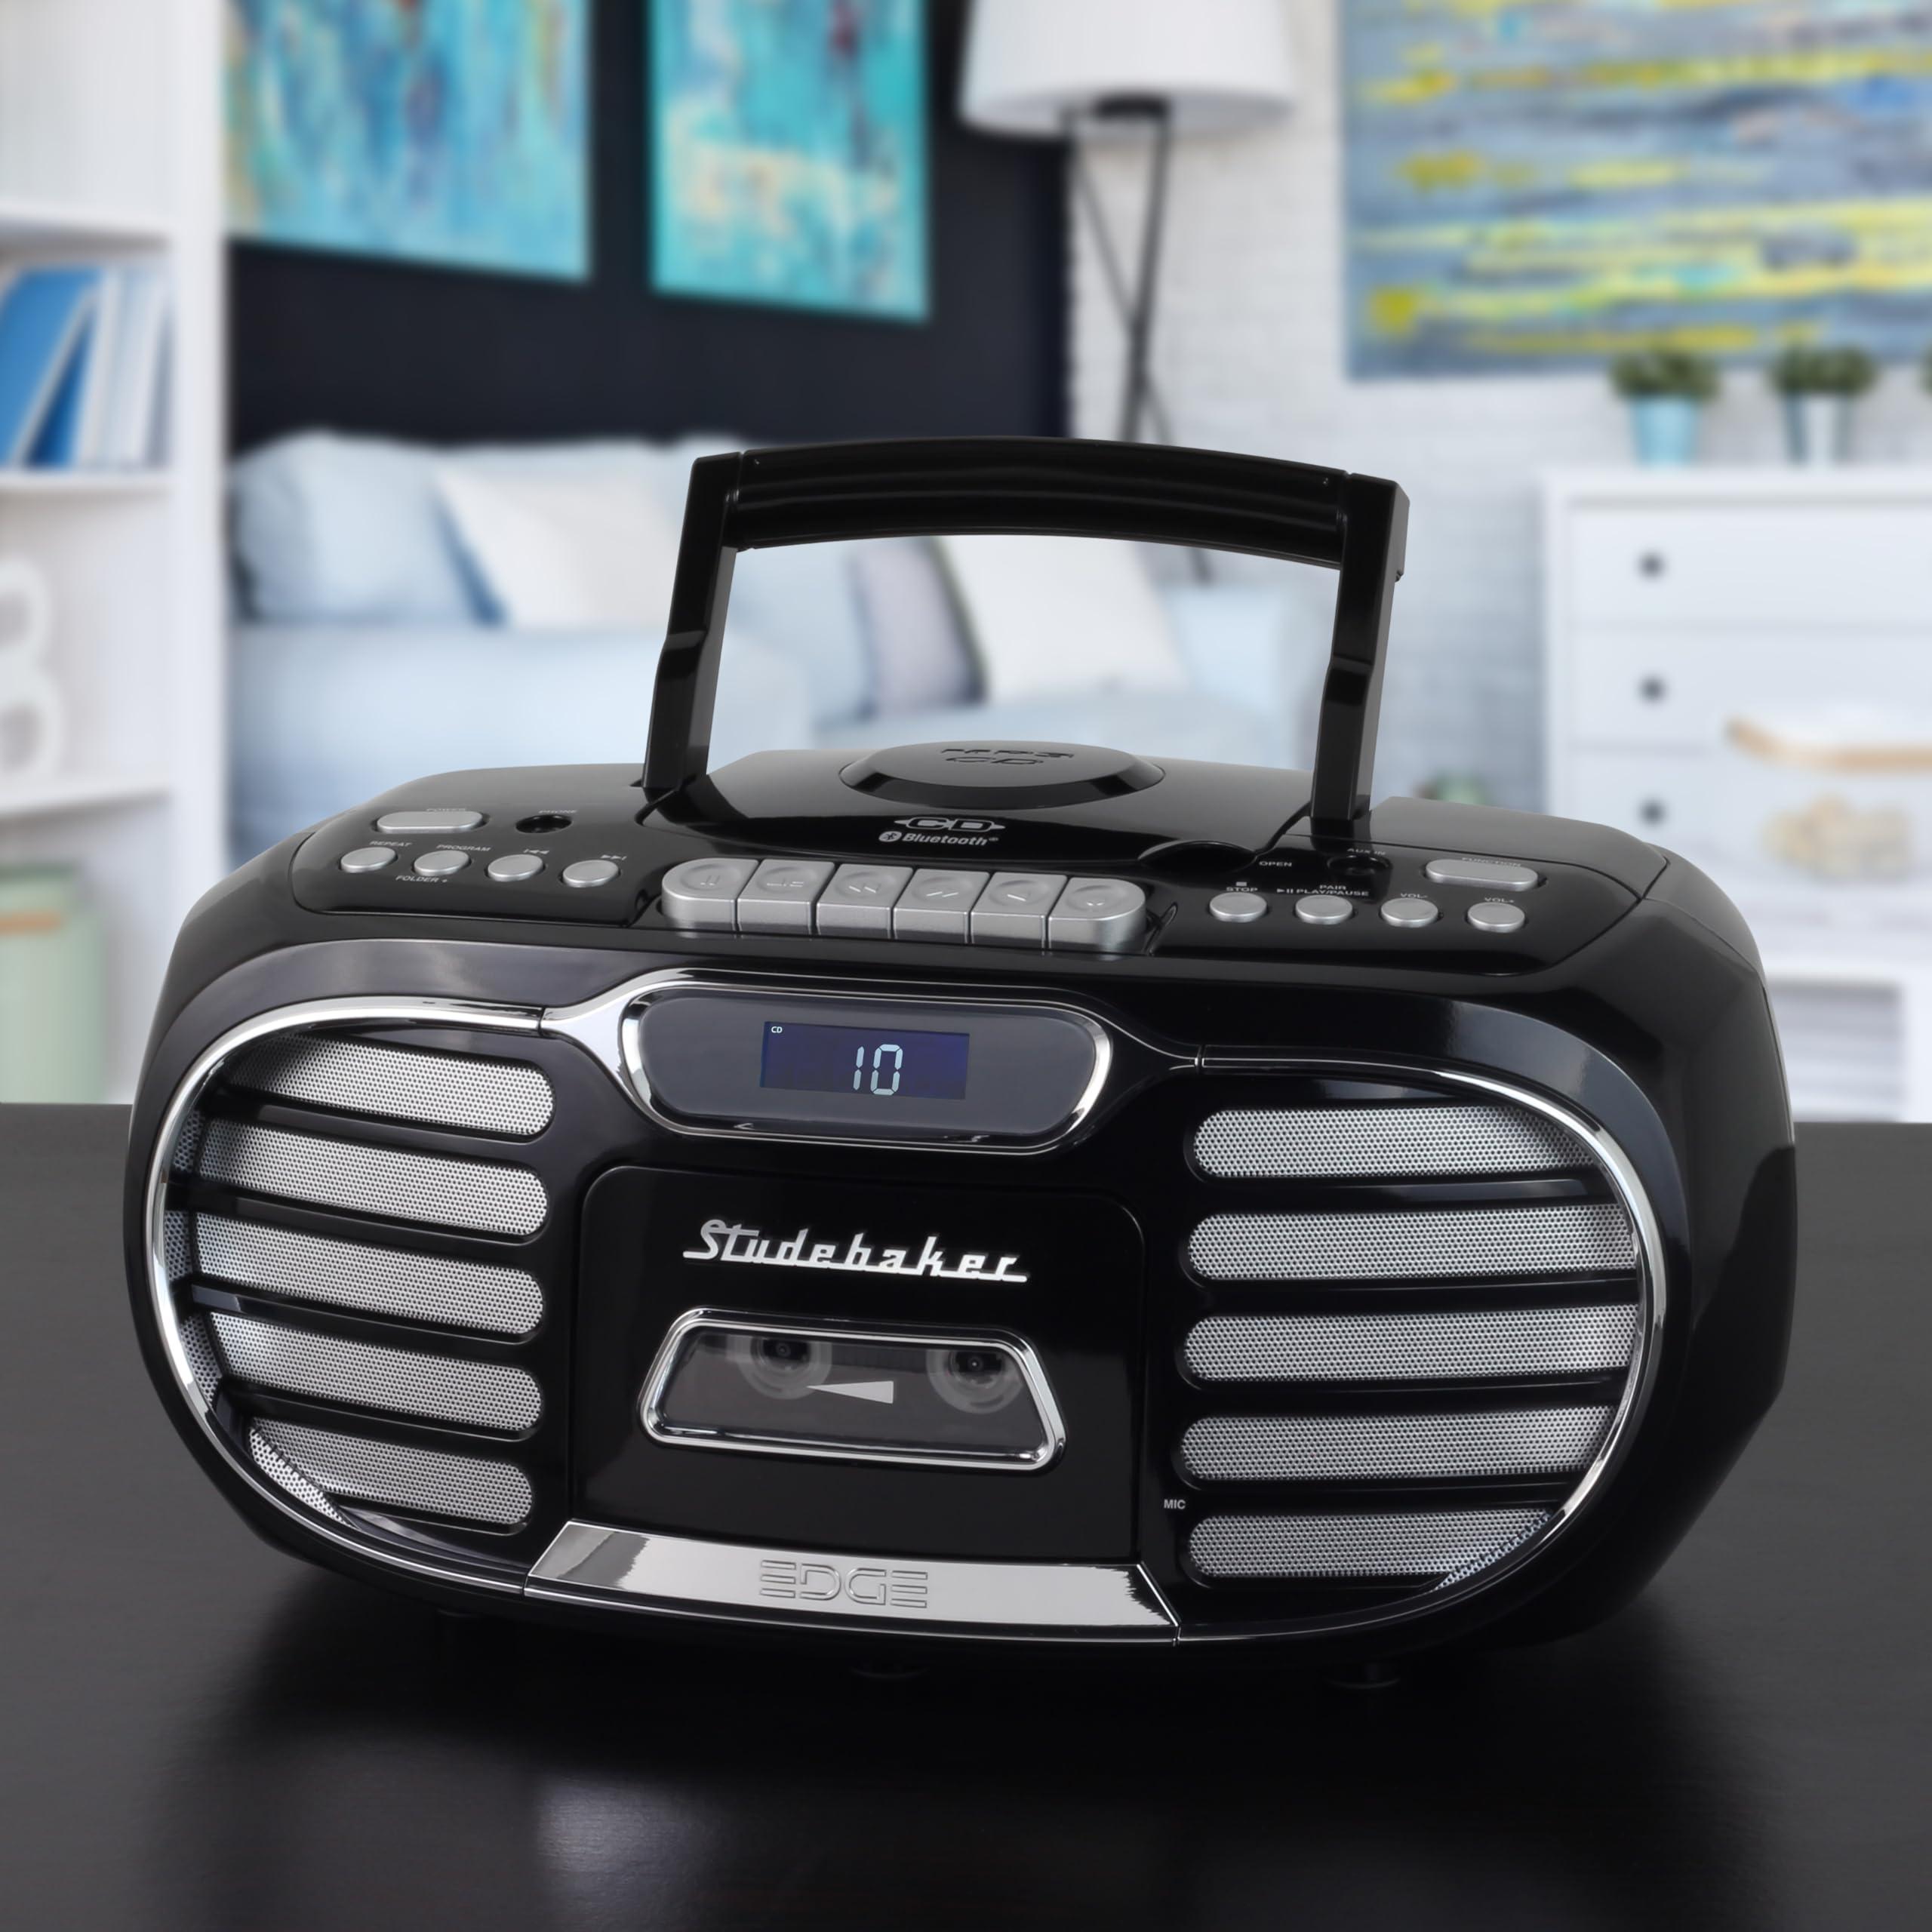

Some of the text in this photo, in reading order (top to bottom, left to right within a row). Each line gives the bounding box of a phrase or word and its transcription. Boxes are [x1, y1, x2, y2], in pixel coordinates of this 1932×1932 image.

[435, 844, 491, 852] PROGRAM
[771, 1026, 783, 1034] CD
[853, 1044, 903, 1096] 10
[683, 1219, 1029, 1282] Studebaker
[1164, 1499, 1186, 1509] MIC
[759, 1559, 928, 1608] EDGE
